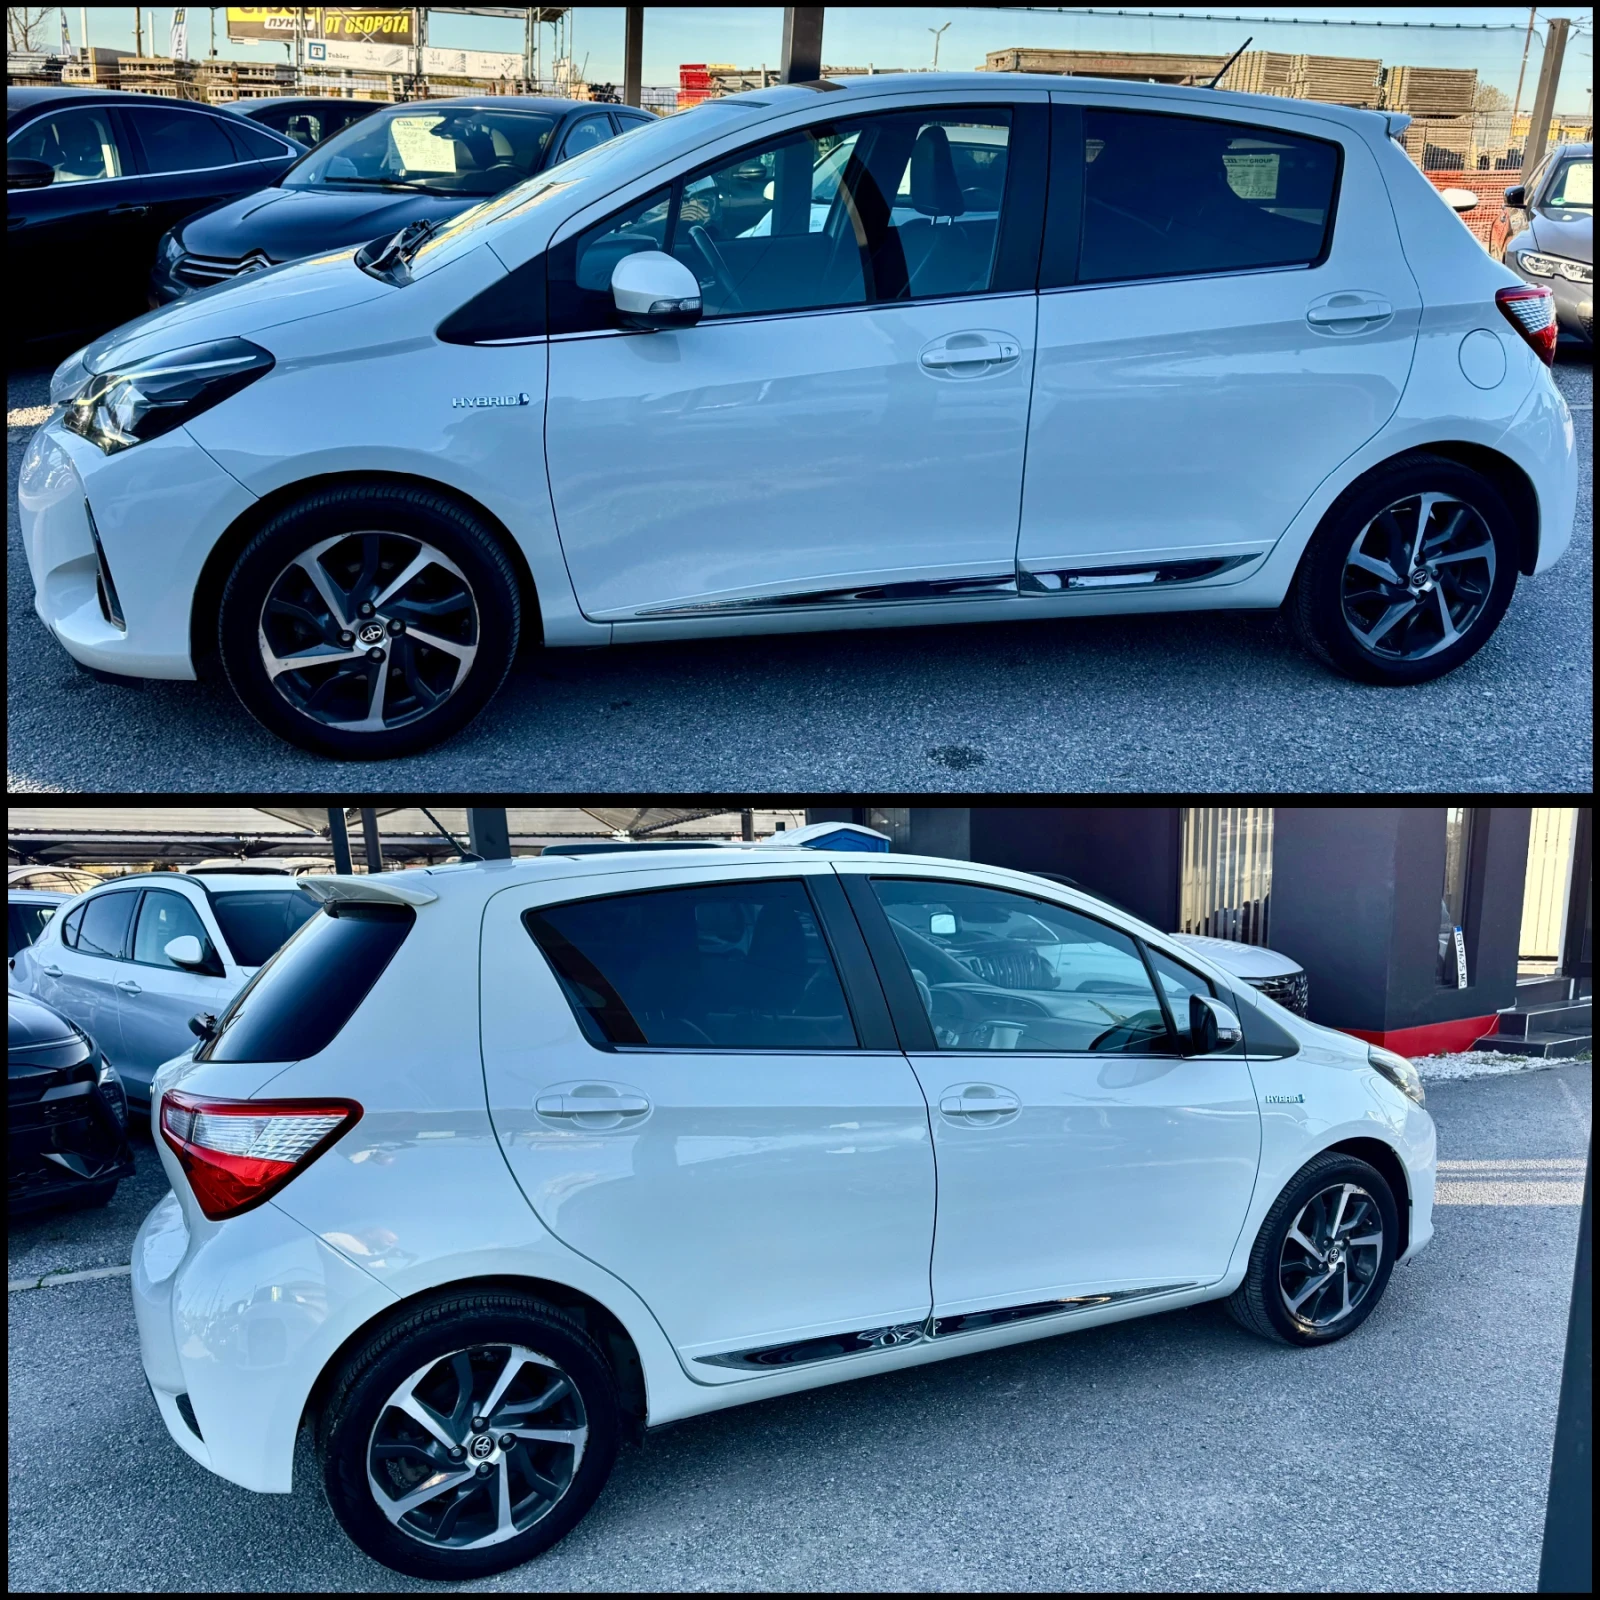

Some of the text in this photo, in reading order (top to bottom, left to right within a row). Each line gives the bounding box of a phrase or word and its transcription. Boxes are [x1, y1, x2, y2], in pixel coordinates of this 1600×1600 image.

[268, 18, 312, 29] ПУНТ
[325, 15, 409, 34] ОТ ОБОРОТА
[452, 395, 517, 408] HYBRID
[1265, 1095, 1299, 1104] HYBRID
